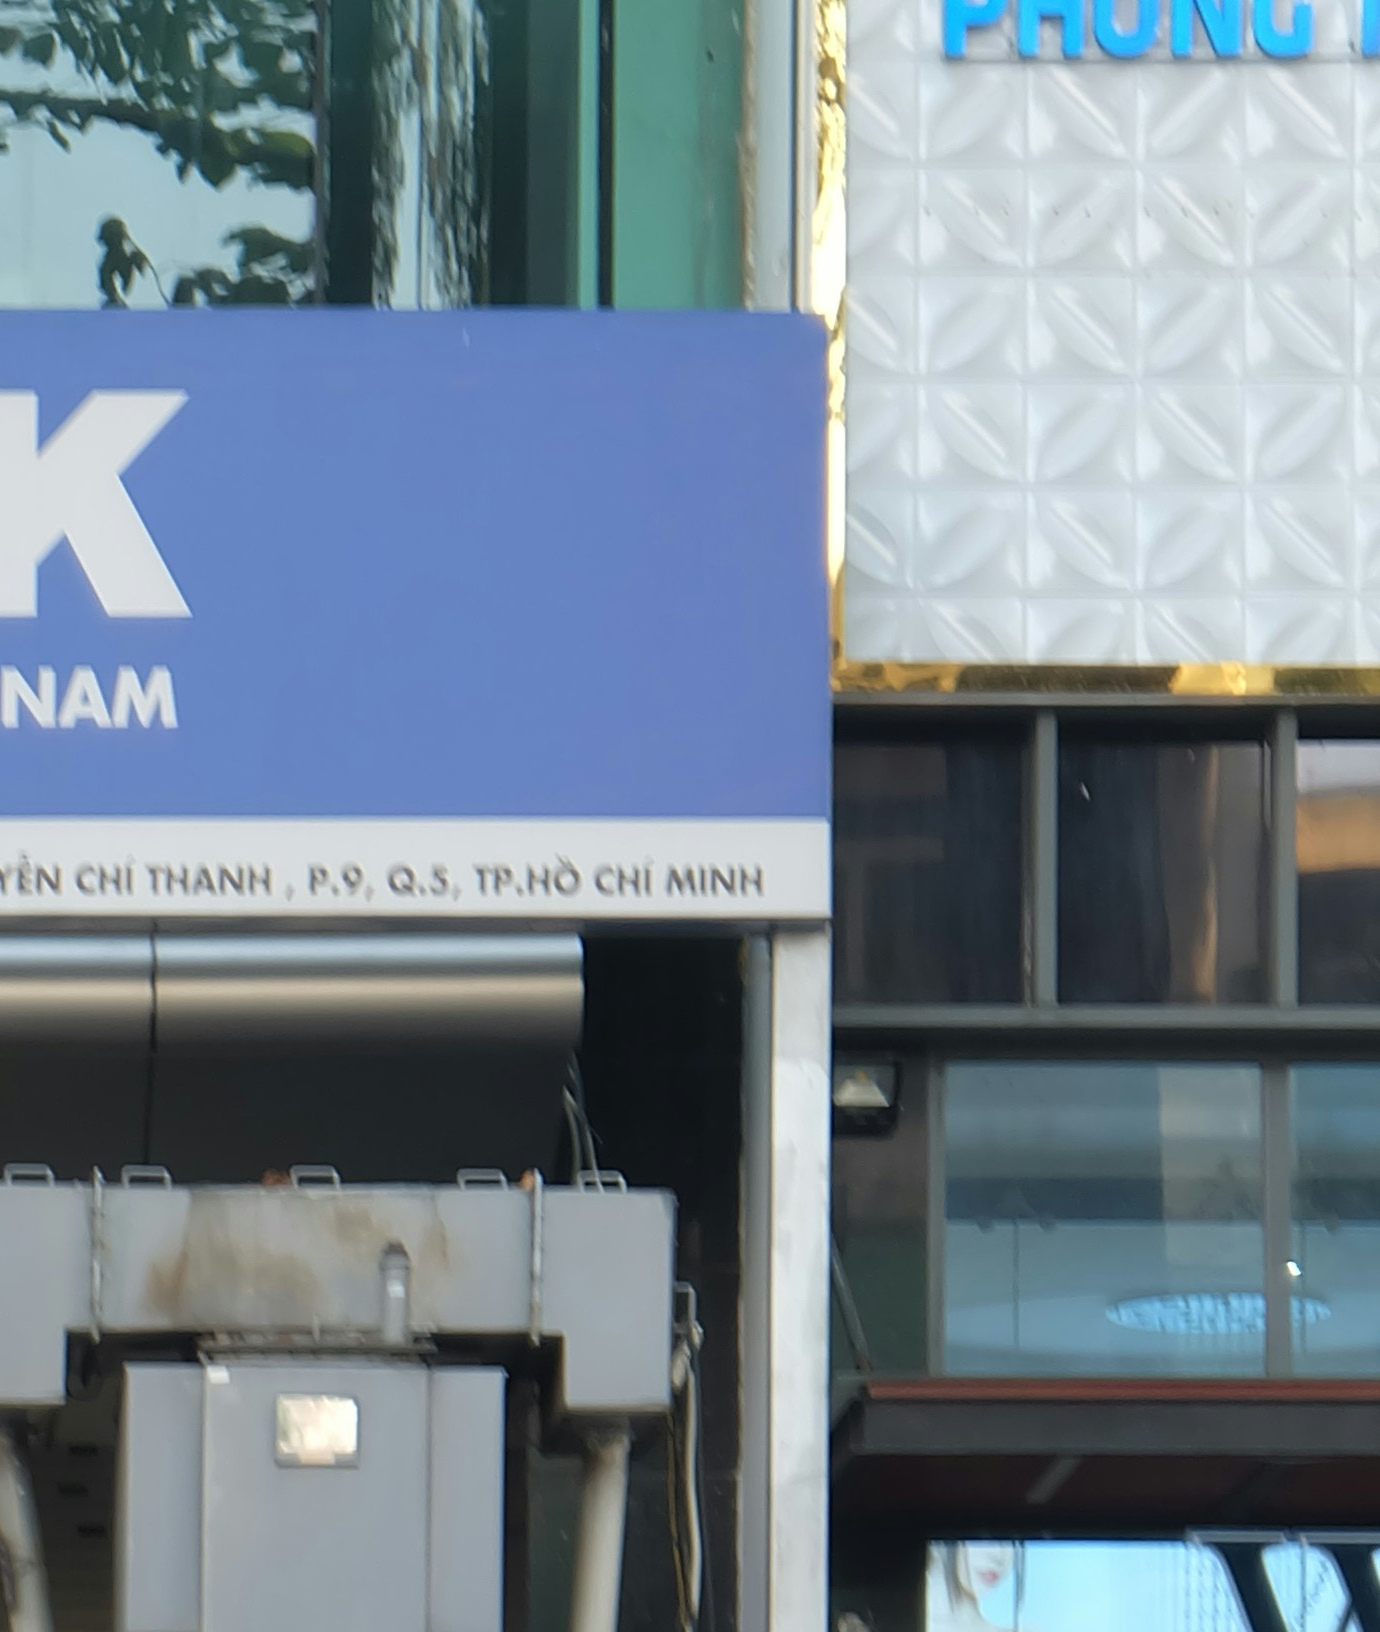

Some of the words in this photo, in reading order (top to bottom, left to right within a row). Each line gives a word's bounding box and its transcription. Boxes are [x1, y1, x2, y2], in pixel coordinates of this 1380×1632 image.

[0, 665, 178, 730] NAM
[146, 863, 273, 896] THANH
[665, 864, 764, 897] MINH
